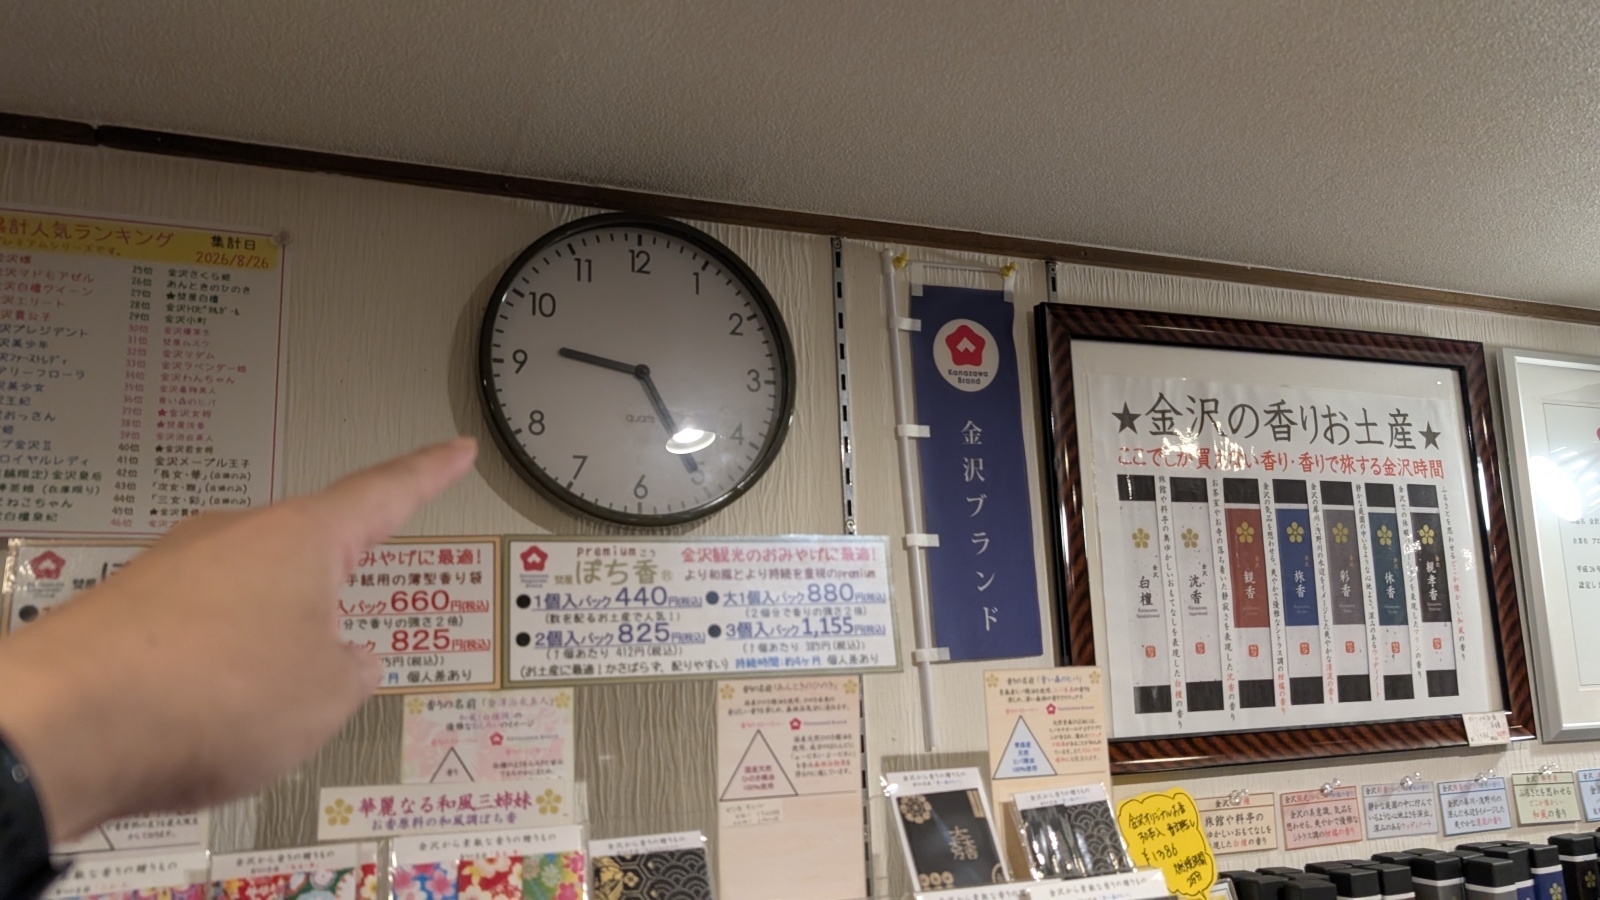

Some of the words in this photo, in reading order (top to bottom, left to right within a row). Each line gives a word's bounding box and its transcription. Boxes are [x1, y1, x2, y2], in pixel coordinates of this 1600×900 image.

[211, 235, 256, 250] 集計日
[195, 251, 269, 269] 2026/8/26
[627, 249, 651, 275] 12
[132, 265, 153, 275] 25位
[573, 257, 593, 283] 11
[131, 276, 152, 287] 26位
[692, 272, 700, 295] 1
[0, 283, 94, 297] 沢白檀クイーン
[130, 288, 151, 299] 27位
[129, 300, 150, 310] 28位
[529, 291, 556, 318] 10
[128, 311, 150, 322] 29位
[128, 323, 149, 333] 30位
[728, 312, 744, 336] 2
[127, 335, 148, 345] 31位
[127, 347, 147, 357] 32位
[126, 358, 147, 369] 33位
[512, 348, 528, 374] 9
[125, 370, 146, 380] 34位
[947, 368, 989, 378] Kanazawa
[746, 368, 761, 393] 3
[957, 376, 981, 385] Brand
[124, 382, 145, 392] 35位
[123, 394, 144, 404] 36位
[0, 410, 56, 422] おっさん
[122, 406, 143, 417] 37位
[121, 418, 142, 428] 38位
[528, 409, 545, 436] 8
[1145, 391, 1417, 450] 金沢の香りお土産
[119, 430, 141, 441] 39位
[729, 421, 745, 445] 4
[117, 443, 140, 453] 40位
[116, 455, 139, 466] 41位
[571, 454, 588, 479] 7
[115, 468, 138, 479] 42位
[114, 481, 136, 491] 43位
[633, 473, 648, 499] 6
[0, 498, 73, 509] ねこちゃん
[113, 493, 135, 504] 44位
[111, 506, 134, 516] 45位
[110, 517, 132, 528] 46位
[960, 419, 999, 632] 金沢ブランド
[576, 545, 637, 558] premium
[1138, 575, 1153, 606] 白檀
[1188, 574, 1202, 605] 沈香
[1384, 571, 1396, 599] 休香
[1578, 581, 1600, 590] 認定し
[407, 670, 472, 684] 個人差あり
[358, 790, 533, 818] 華麗なる和風三姉妹
[1532, 807, 1568, 820] 和風の香り
[371, 812, 518, 832] お香原料の和風調ぽち香
[1204, 812, 1264, 828] 旅館や料亭の
